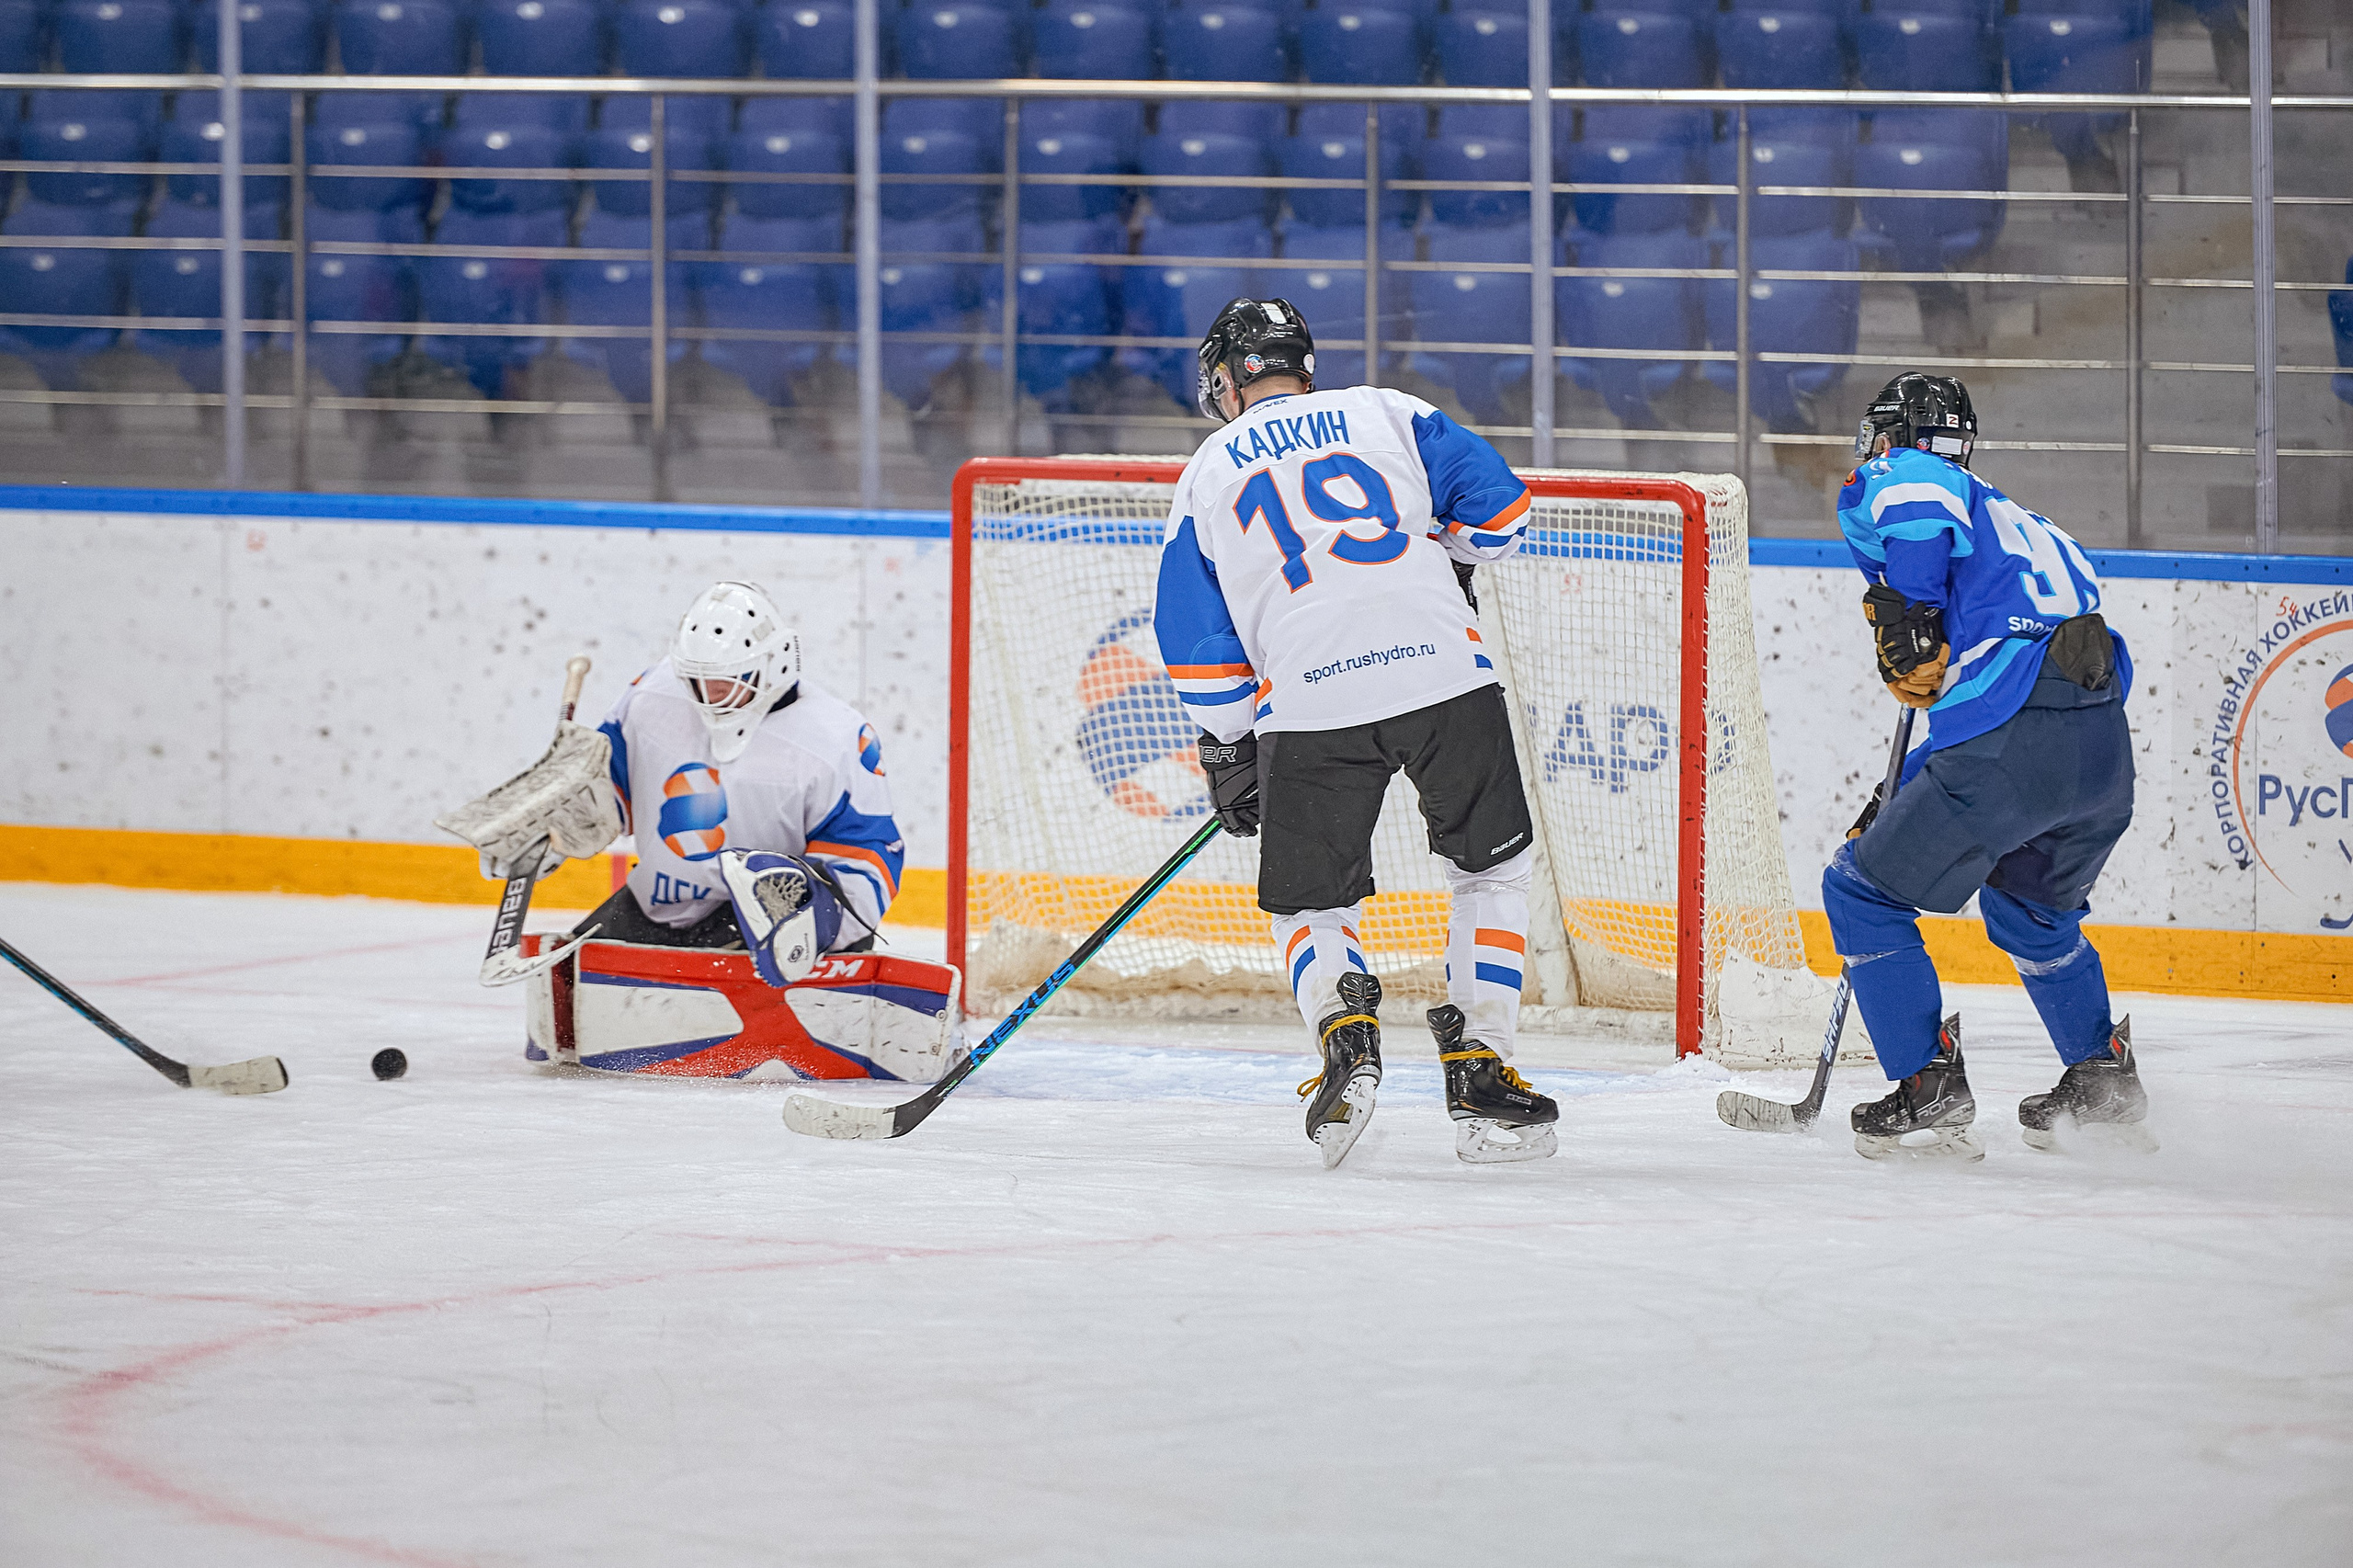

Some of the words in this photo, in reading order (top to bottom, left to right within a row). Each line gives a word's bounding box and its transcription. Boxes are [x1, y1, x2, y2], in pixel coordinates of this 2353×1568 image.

[1225, 410, 1350, 469] КАДКИН
[1233, 451, 1410, 594] 19
[2276, 596, 2298, 617] 54
[1303, 642, 1435, 684] sport.rushydro.ru
[2211, 649, 2263, 871] КОРПОРАТИВНАЯ
[2259, 590, 2353, 653] ХОККЕЙ
[805, 952, 865, 979] CM
[970, 958, 1075, 1066] NEXUS
